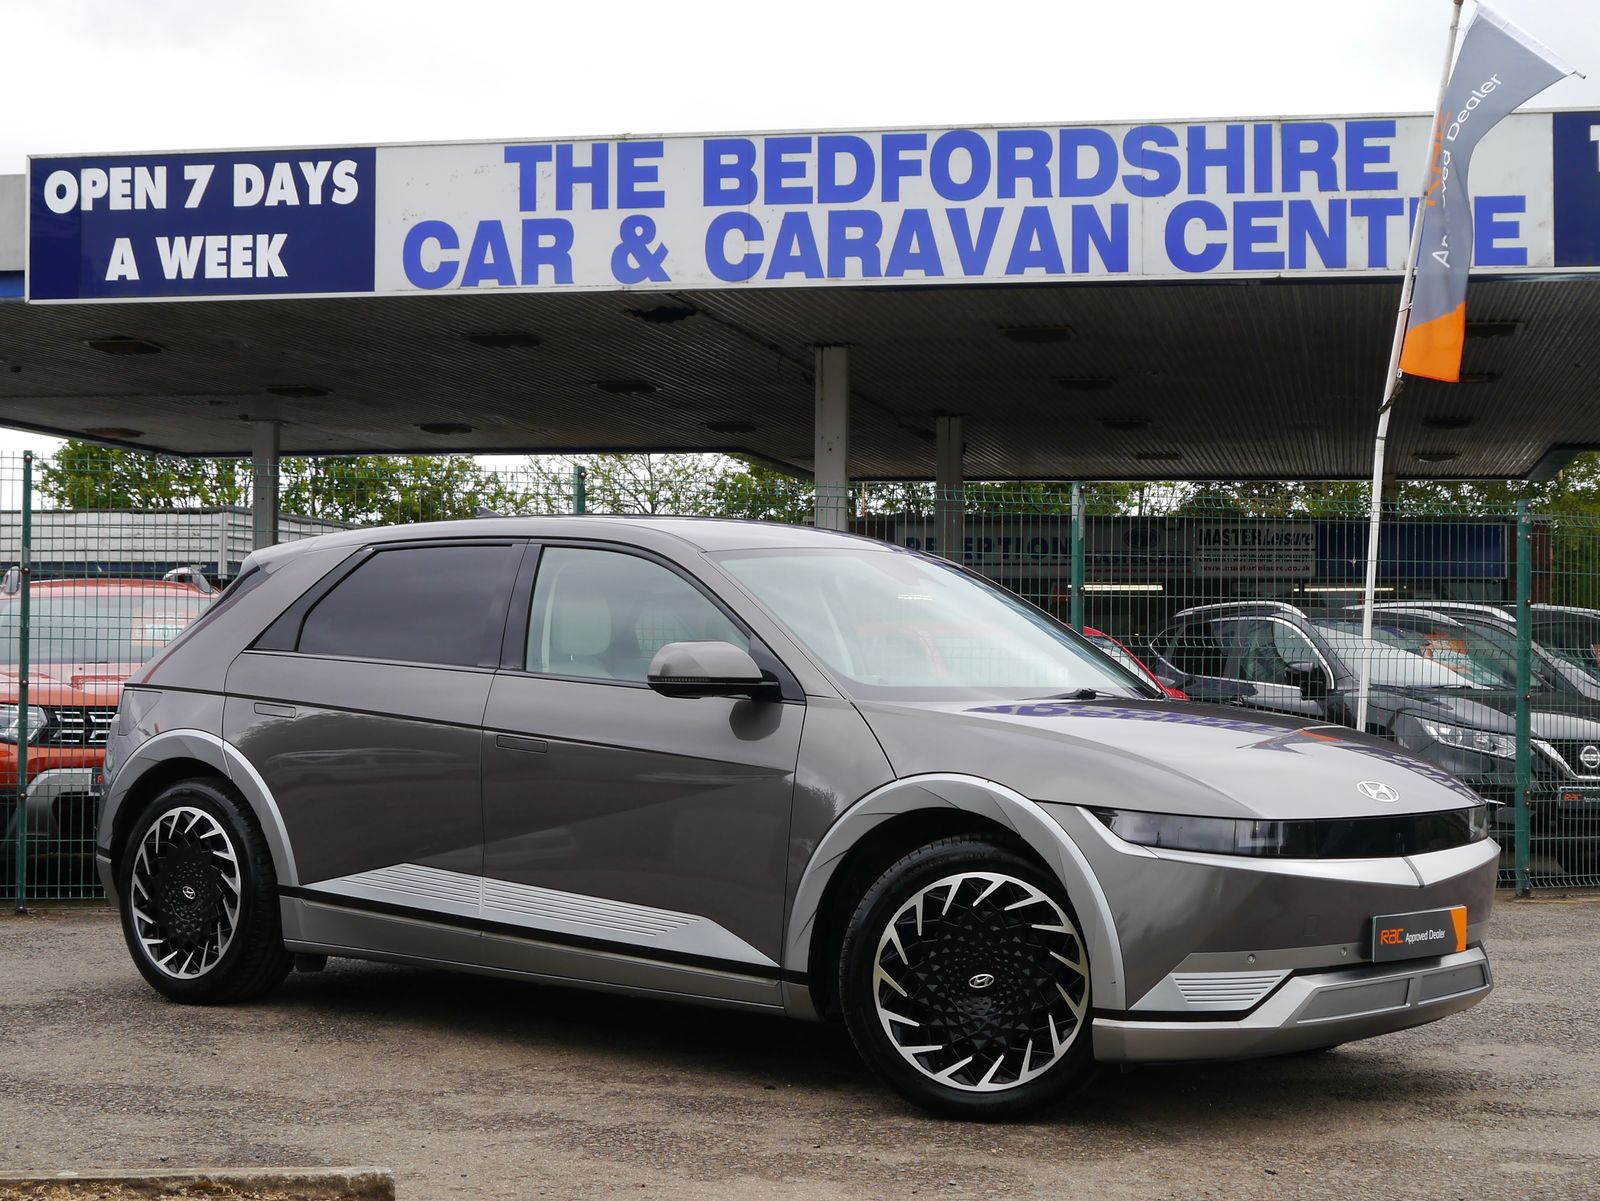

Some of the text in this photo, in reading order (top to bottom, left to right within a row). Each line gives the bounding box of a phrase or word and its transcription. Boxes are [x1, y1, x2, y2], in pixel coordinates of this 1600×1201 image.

[1446, 73, 1502, 142] Dealer
[44, 160, 359, 214] OPEN 7 DAYS
[504, 141, 665, 211] THE
[703, 120, 1398, 208] BEDFORDSHIRE
[105, 234, 289, 281] A WEEK
[402, 218, 574, 289] CAR
[610, 215, 671, 285] &
[705, 203, 1130, 283] CARAVAN
[904, 536, 1073, 560] REEPTION
[1200, 564, 1311, 572] www.mastereisure.co.uk
[1405, 930, 1428, 945] Approved
[1428, 929, 1446, 940] Dealer
